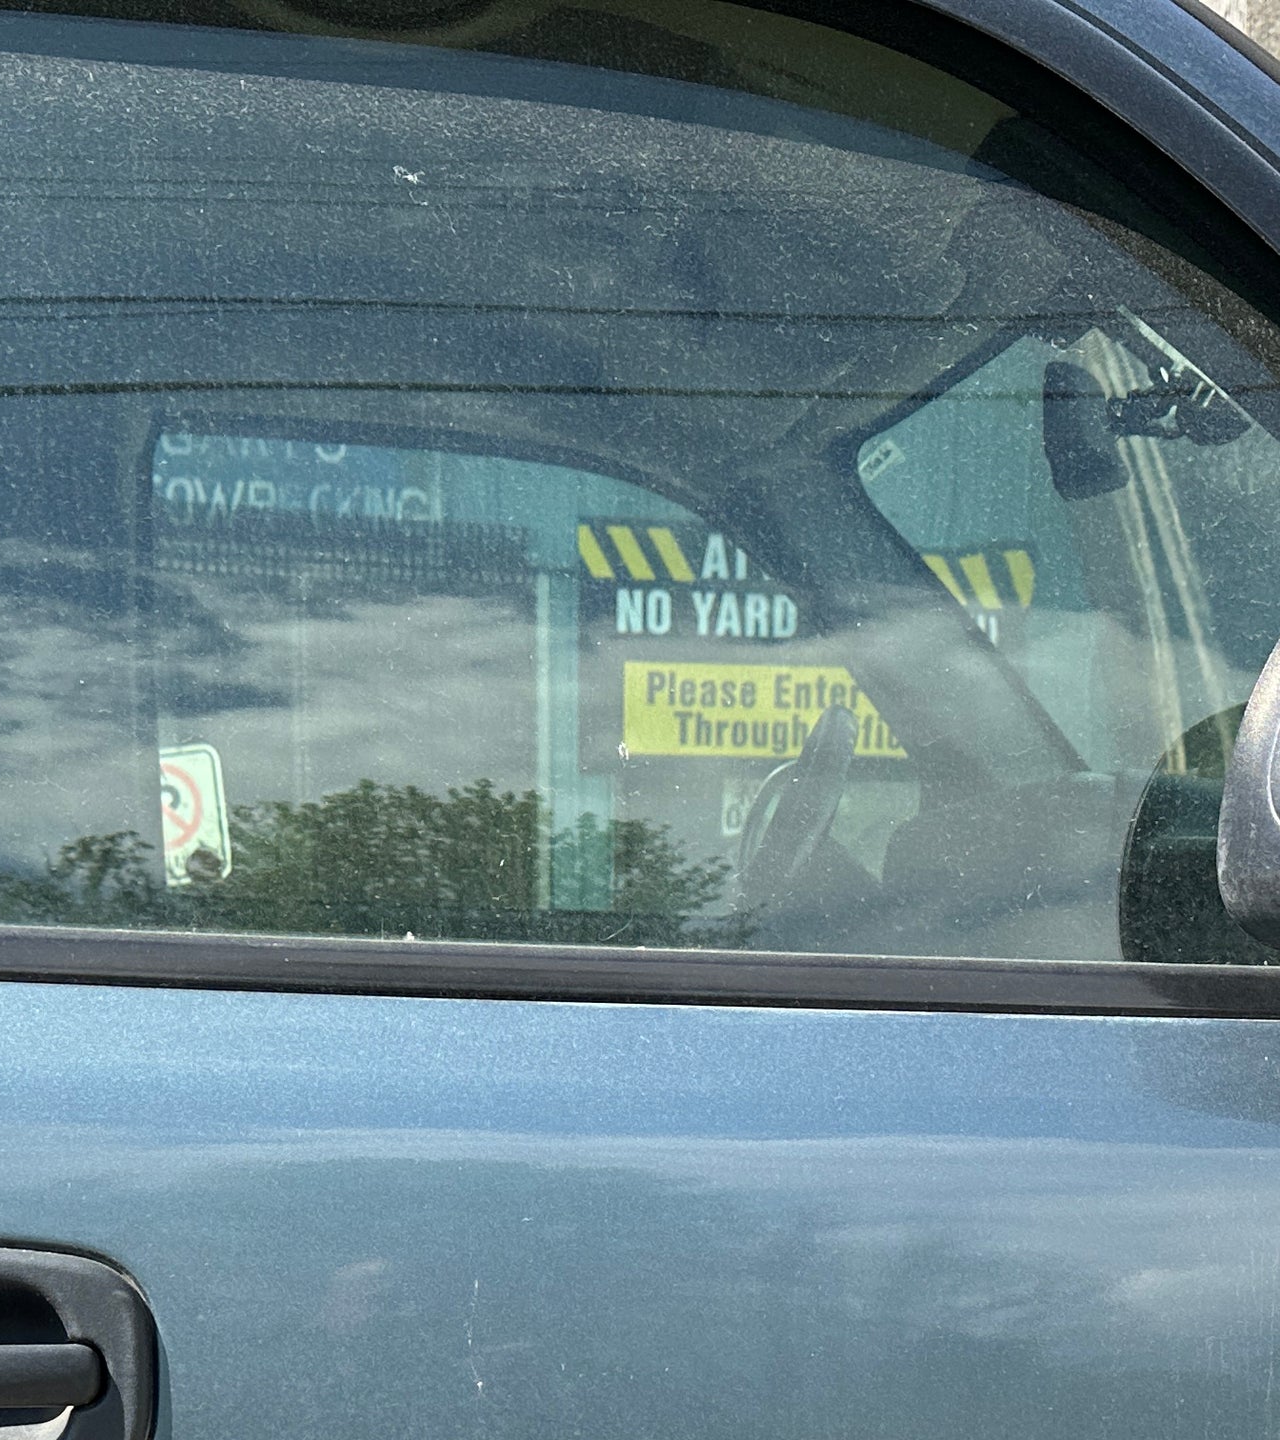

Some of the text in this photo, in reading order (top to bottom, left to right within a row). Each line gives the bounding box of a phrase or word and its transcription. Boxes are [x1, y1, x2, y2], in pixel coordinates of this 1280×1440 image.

[616, 588, 799, 638] NO YARD
[645, 670, 757, 708] Please
[673, 710, 808, 755] Through
